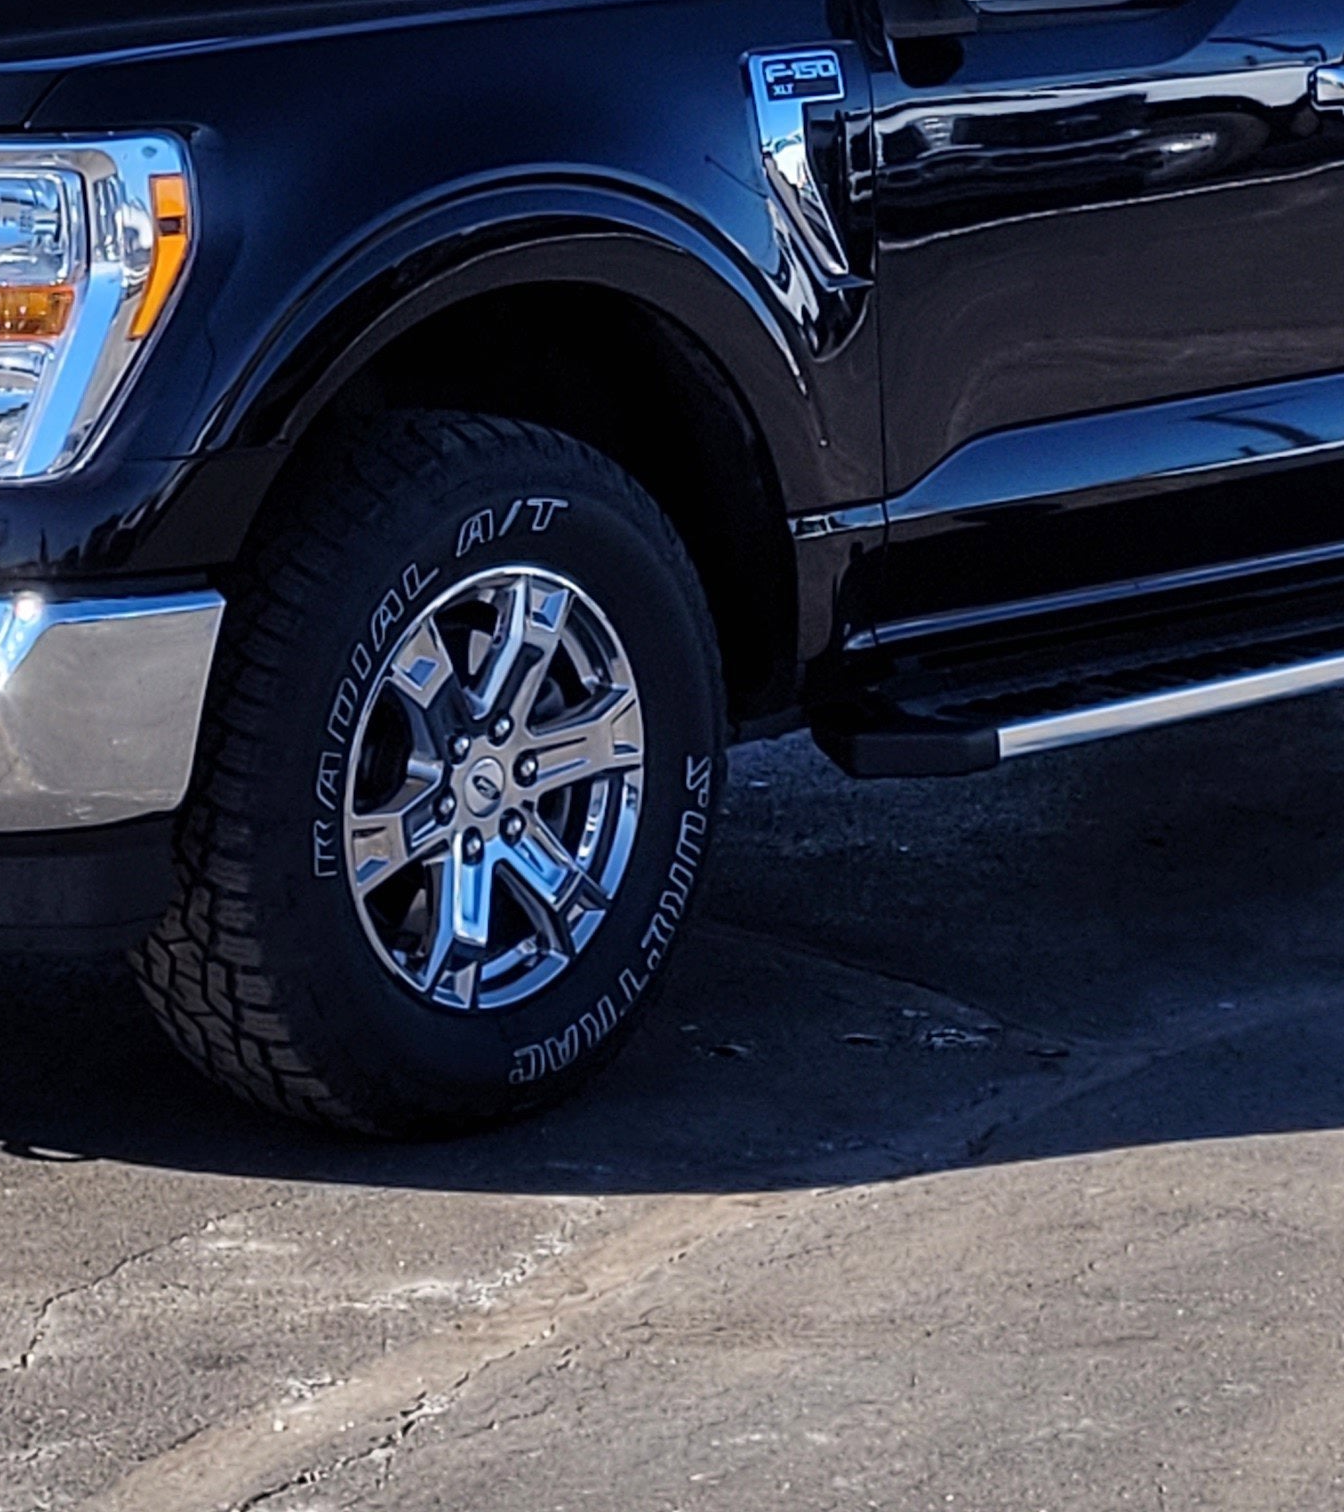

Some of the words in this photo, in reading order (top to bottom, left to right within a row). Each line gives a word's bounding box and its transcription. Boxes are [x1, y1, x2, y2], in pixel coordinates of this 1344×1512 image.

[765, 59, 837, 83] F-150
[772, 83, 794, 96] XLT
[312, 562, 441, 879] RADIAL
[455, 497, 570, 559] A/T
[508, 755, 712, 1085] SURETRAC
